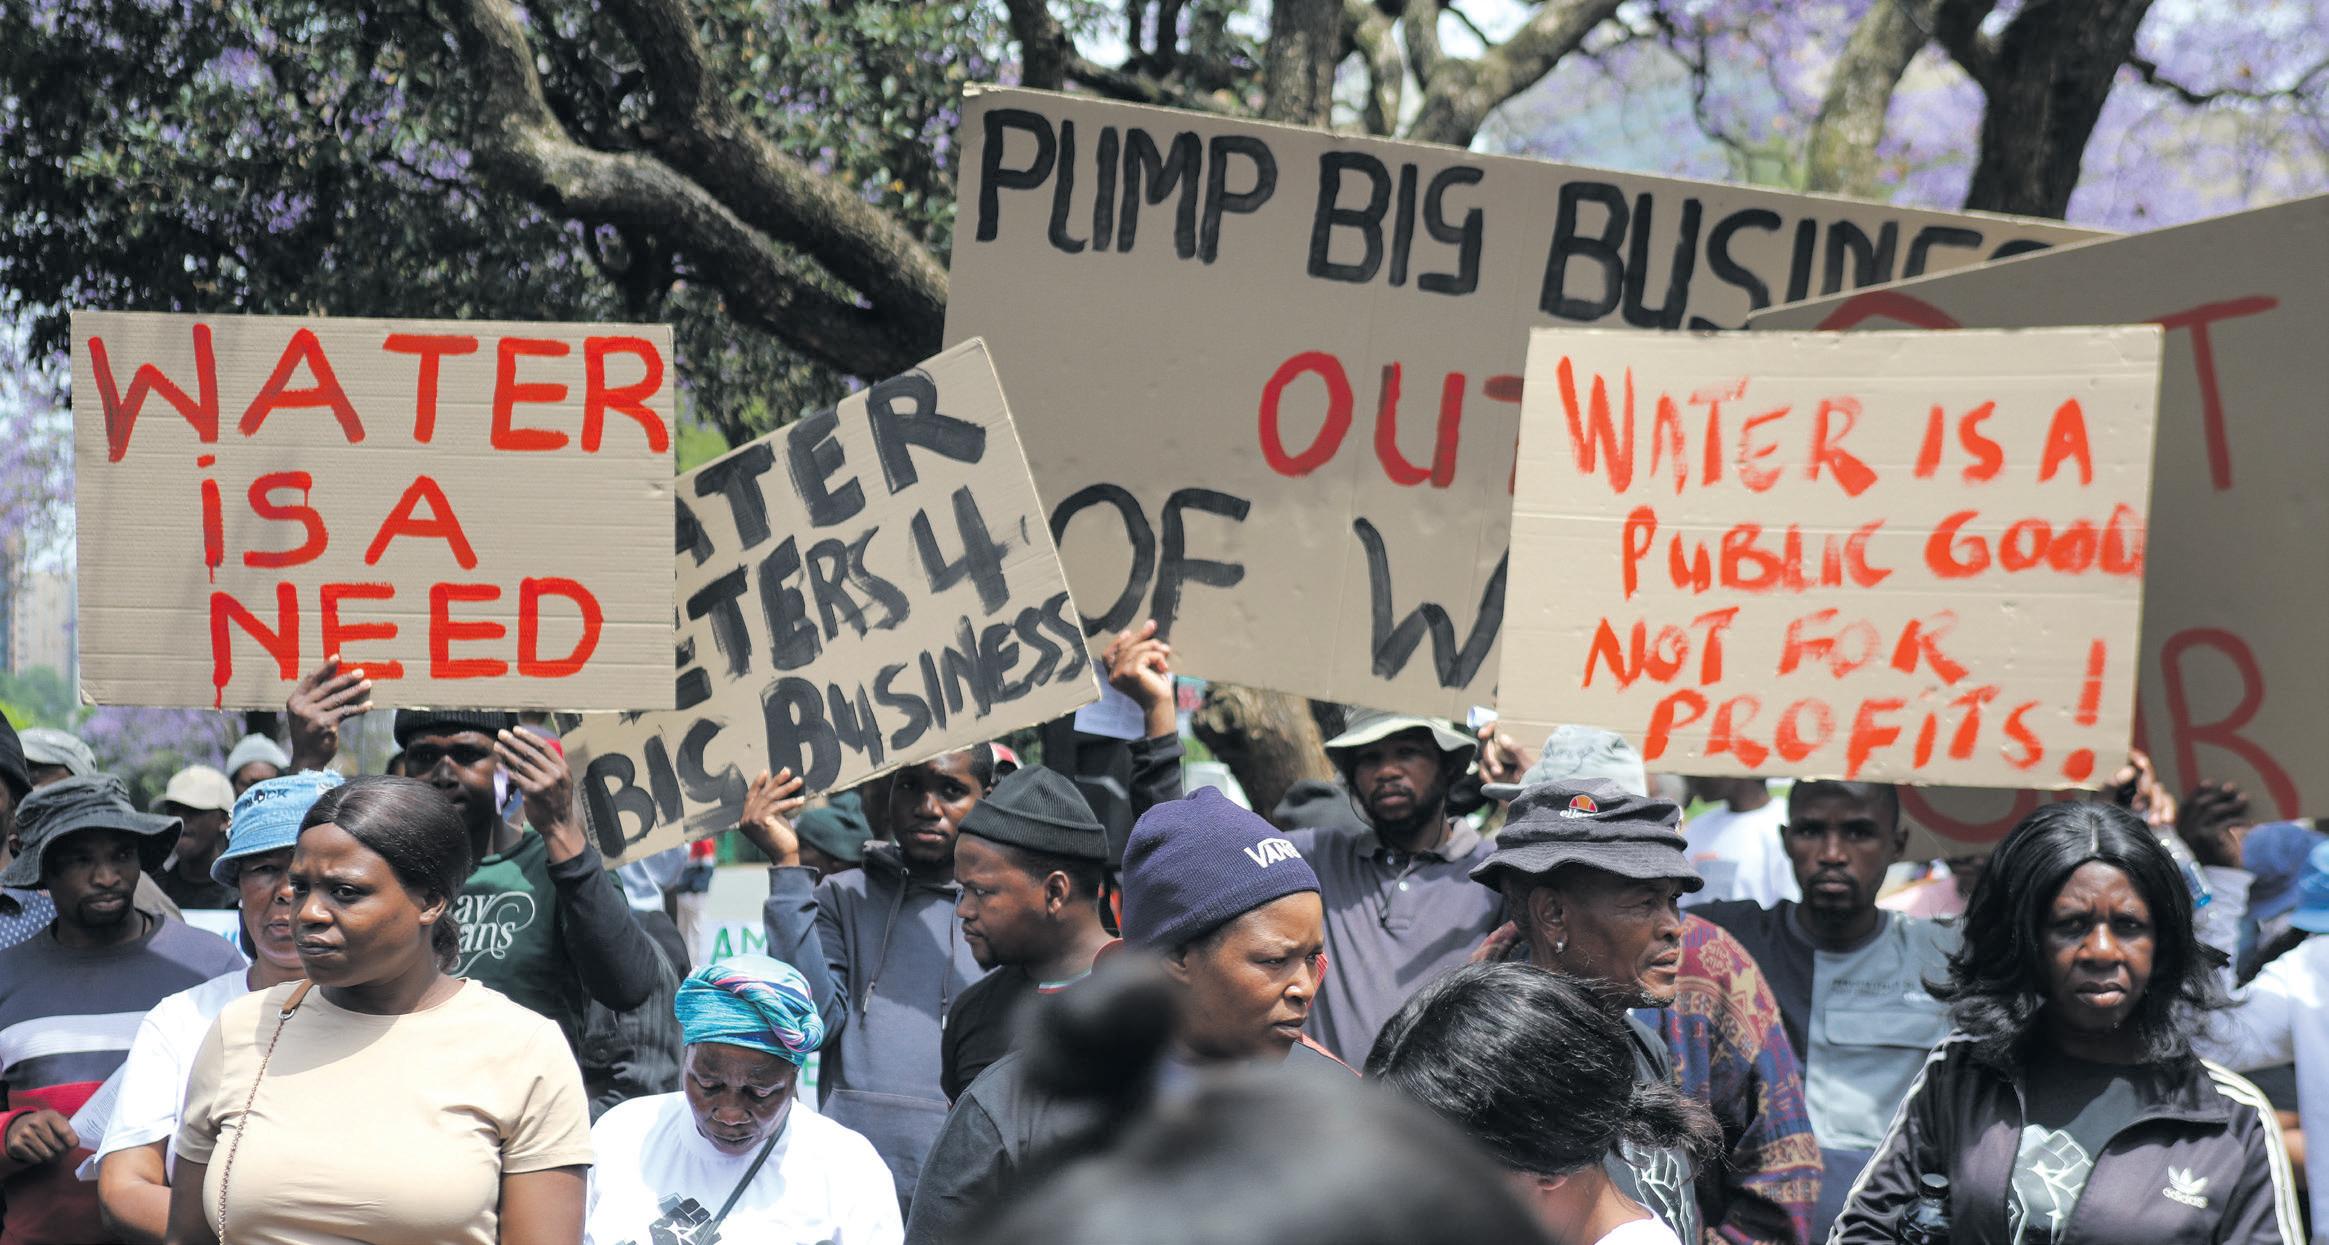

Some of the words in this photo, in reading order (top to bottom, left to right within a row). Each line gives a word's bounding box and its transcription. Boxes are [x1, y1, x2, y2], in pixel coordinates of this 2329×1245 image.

[976, 108, 1278, 264] PUMP
[1307, 151, 1485, 295] BIG
[1539, 181, 2055, 331] BUSIN
[88, 323, 669, 463] WATER
[1556, 355, 1879, 497] WATER
[1914, 400, 2004, 484] IS
[2038, 397, 2093, 486] A
[365, 475, 478, 570] A
[909, 485, 1010, 616] 4
[1050, 483, 1251, 644] OF
[1924, 502, 2147, 581] GOOD
[210, 577, 604, 711] NEED
[1581, 606, 1741, 689] NOT
[1776, 608, 1970, 687] FOR
[581, 717, 749, 858] BIG
[760, 591, 1088, 794] BUSINESS
[2162, 1187, 2209, 1209] adidas
